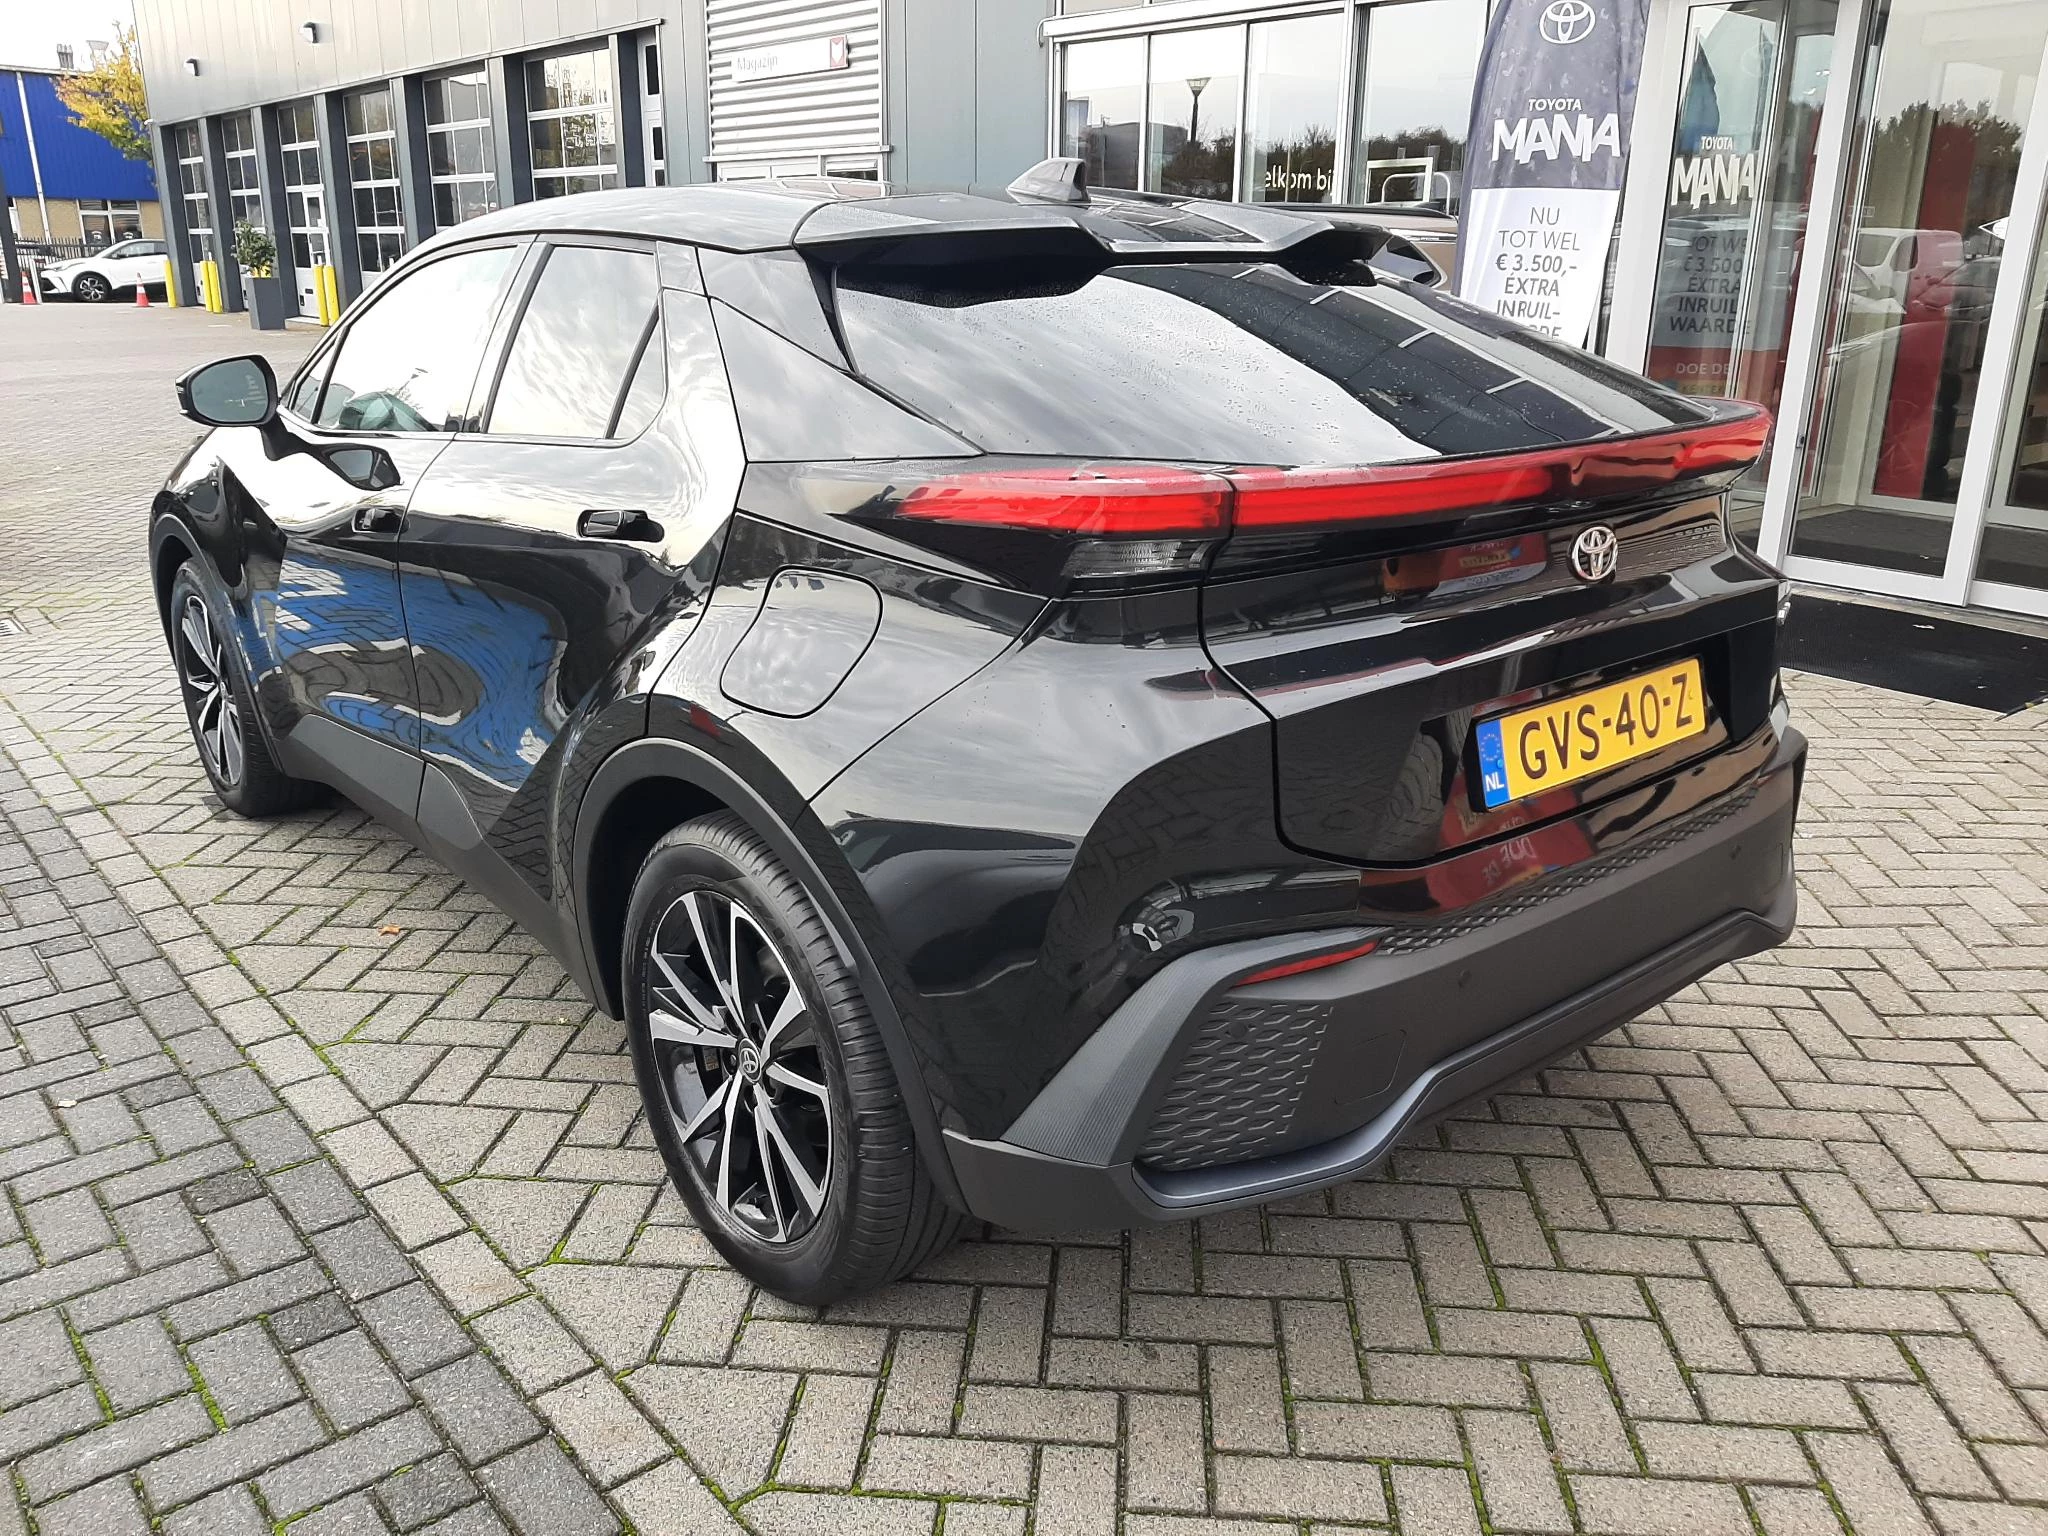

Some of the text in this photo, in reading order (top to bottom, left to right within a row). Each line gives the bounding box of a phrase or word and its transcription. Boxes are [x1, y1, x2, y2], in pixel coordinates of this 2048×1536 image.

[1528, 99, 1582, 112] TOYOTA
[1491, 113, 1621, 164] MANIA
[1701, 136, 1734, 150] TOYOTA
[1671, 153, 1755, 209] MANIA
[1530, 207, 1560, 226] NU
[1499, 230, 1581, 251] TOT WEL
[1496, 299, 1561, 320] INRUIL-
[1676, 362, 1707, 376] DOE
[1519, 672, 1693, 780] GVS-40-Z
[1485, 772, 1505, 792] NL
